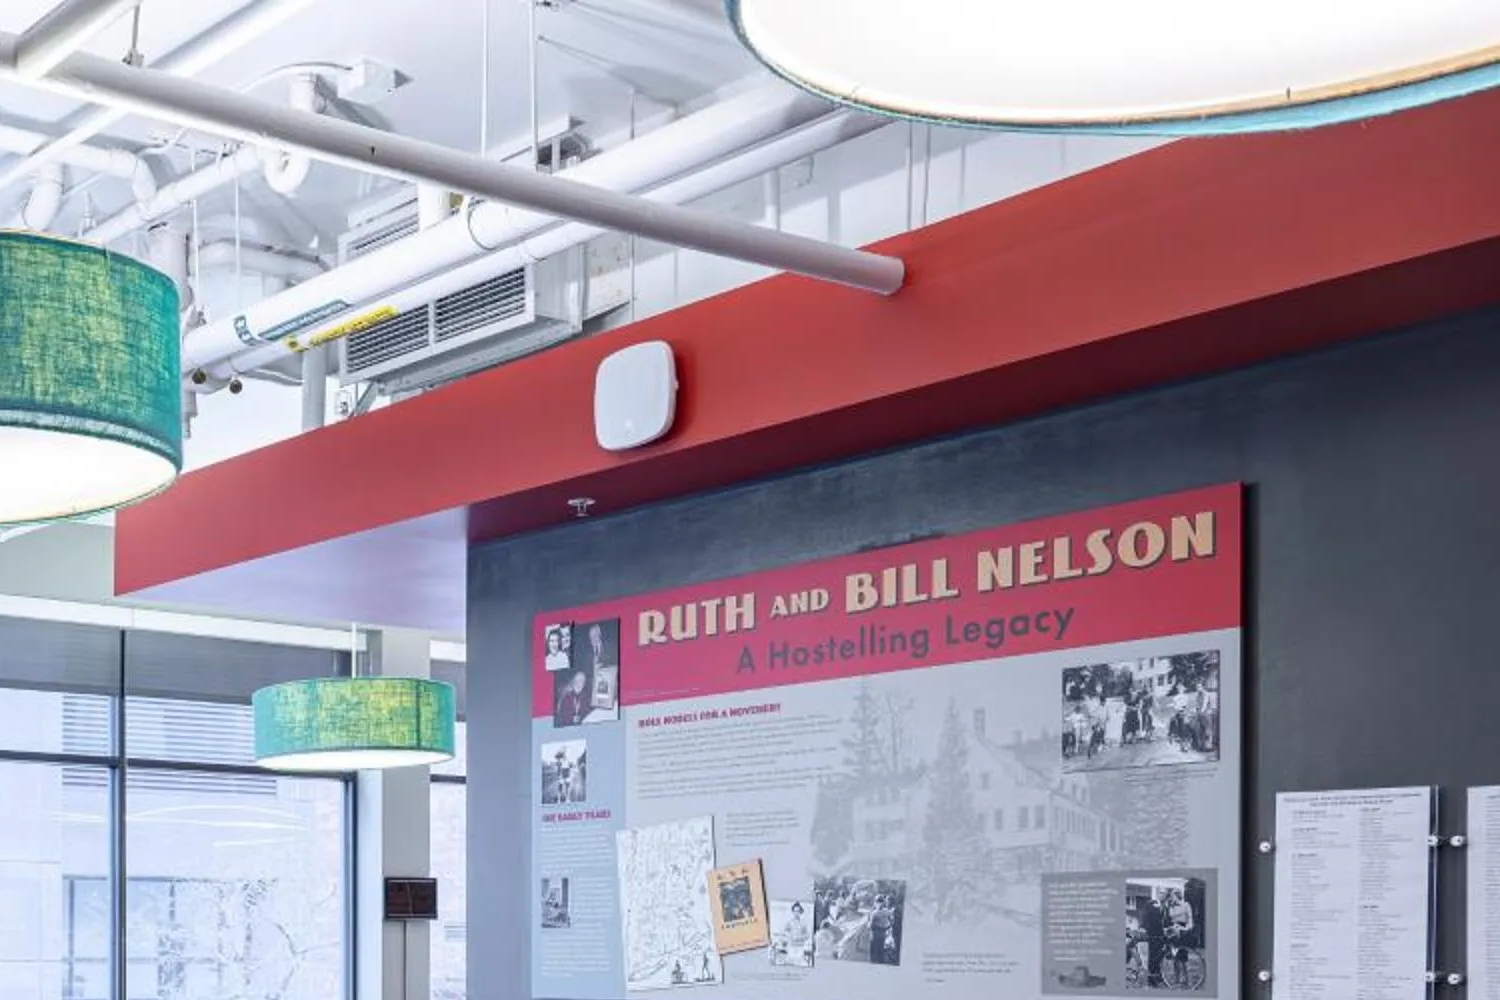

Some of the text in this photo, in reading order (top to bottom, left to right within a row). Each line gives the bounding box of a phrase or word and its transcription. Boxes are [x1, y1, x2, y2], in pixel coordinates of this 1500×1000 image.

[638, 511, 1216, 646] RUTH AND BILL NELSON
[737, 607, 1075, 674] A Hostelling Legacy
